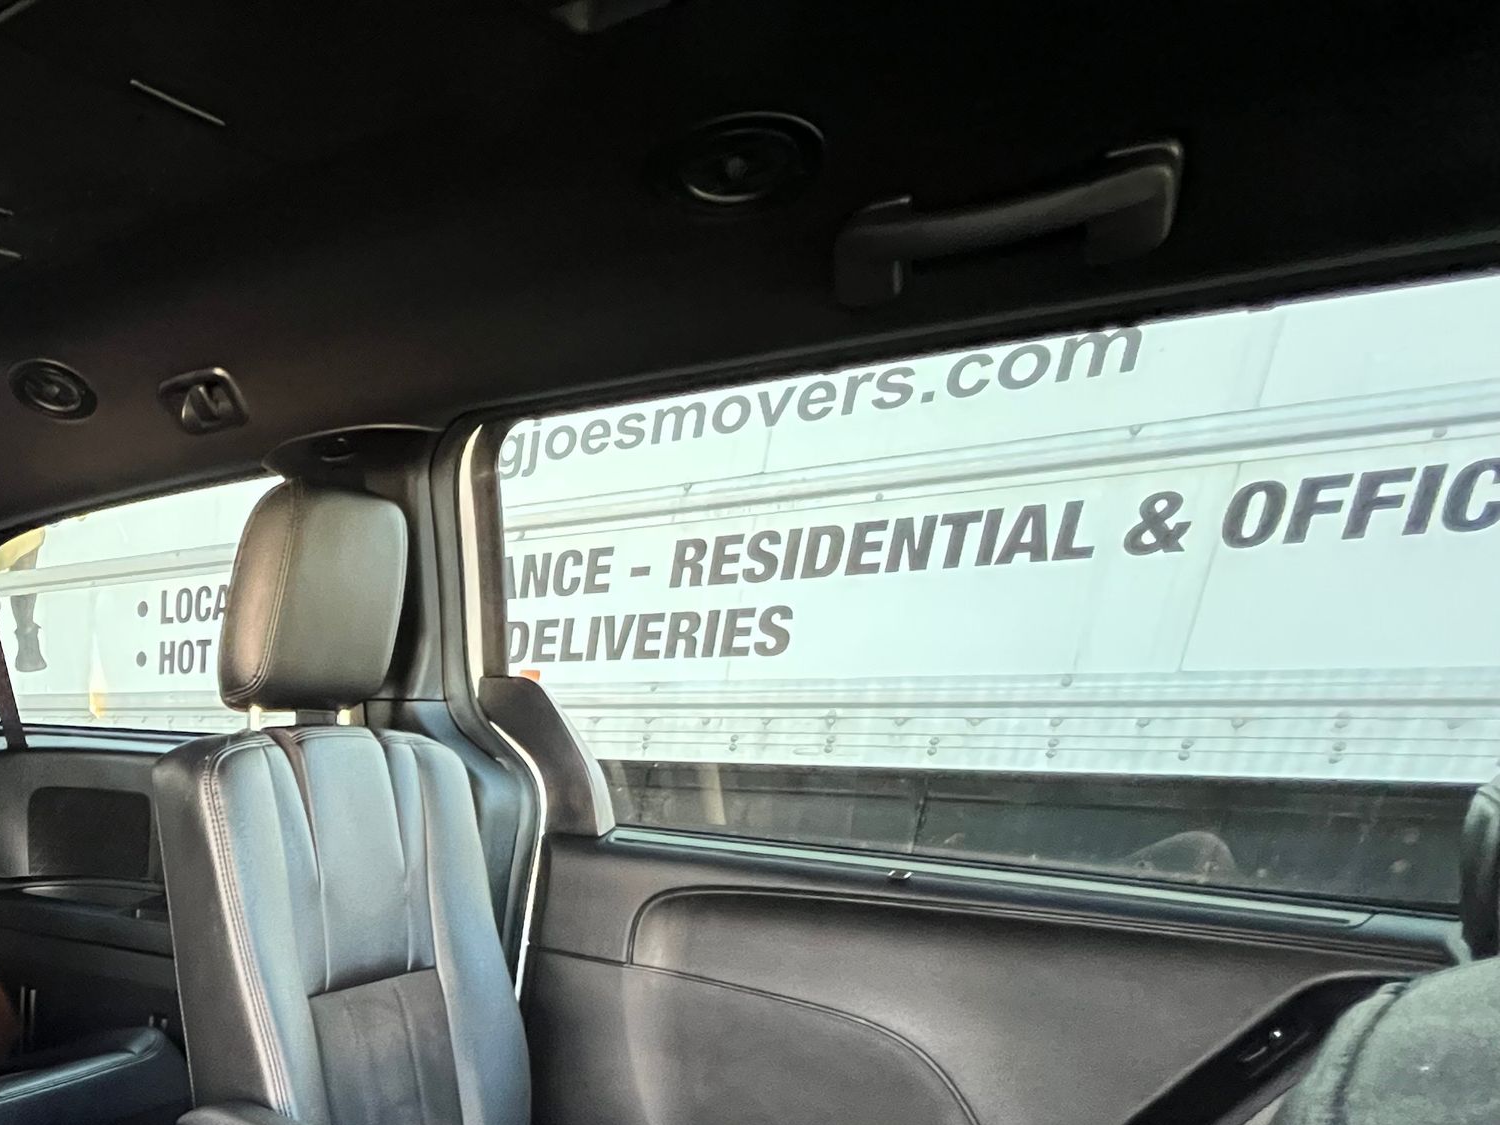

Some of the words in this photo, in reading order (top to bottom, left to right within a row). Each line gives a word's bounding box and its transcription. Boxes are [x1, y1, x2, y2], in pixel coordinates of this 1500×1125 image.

[500, 327, 1143, 480] gjoesmovers.com
[669, 500, 1095, 588] RESIDENTIAL
[1123, 490, 1192, 556] &
[158, 638, 213, 675] HOT
[506, 605, 794, 664] DELIVERIES
